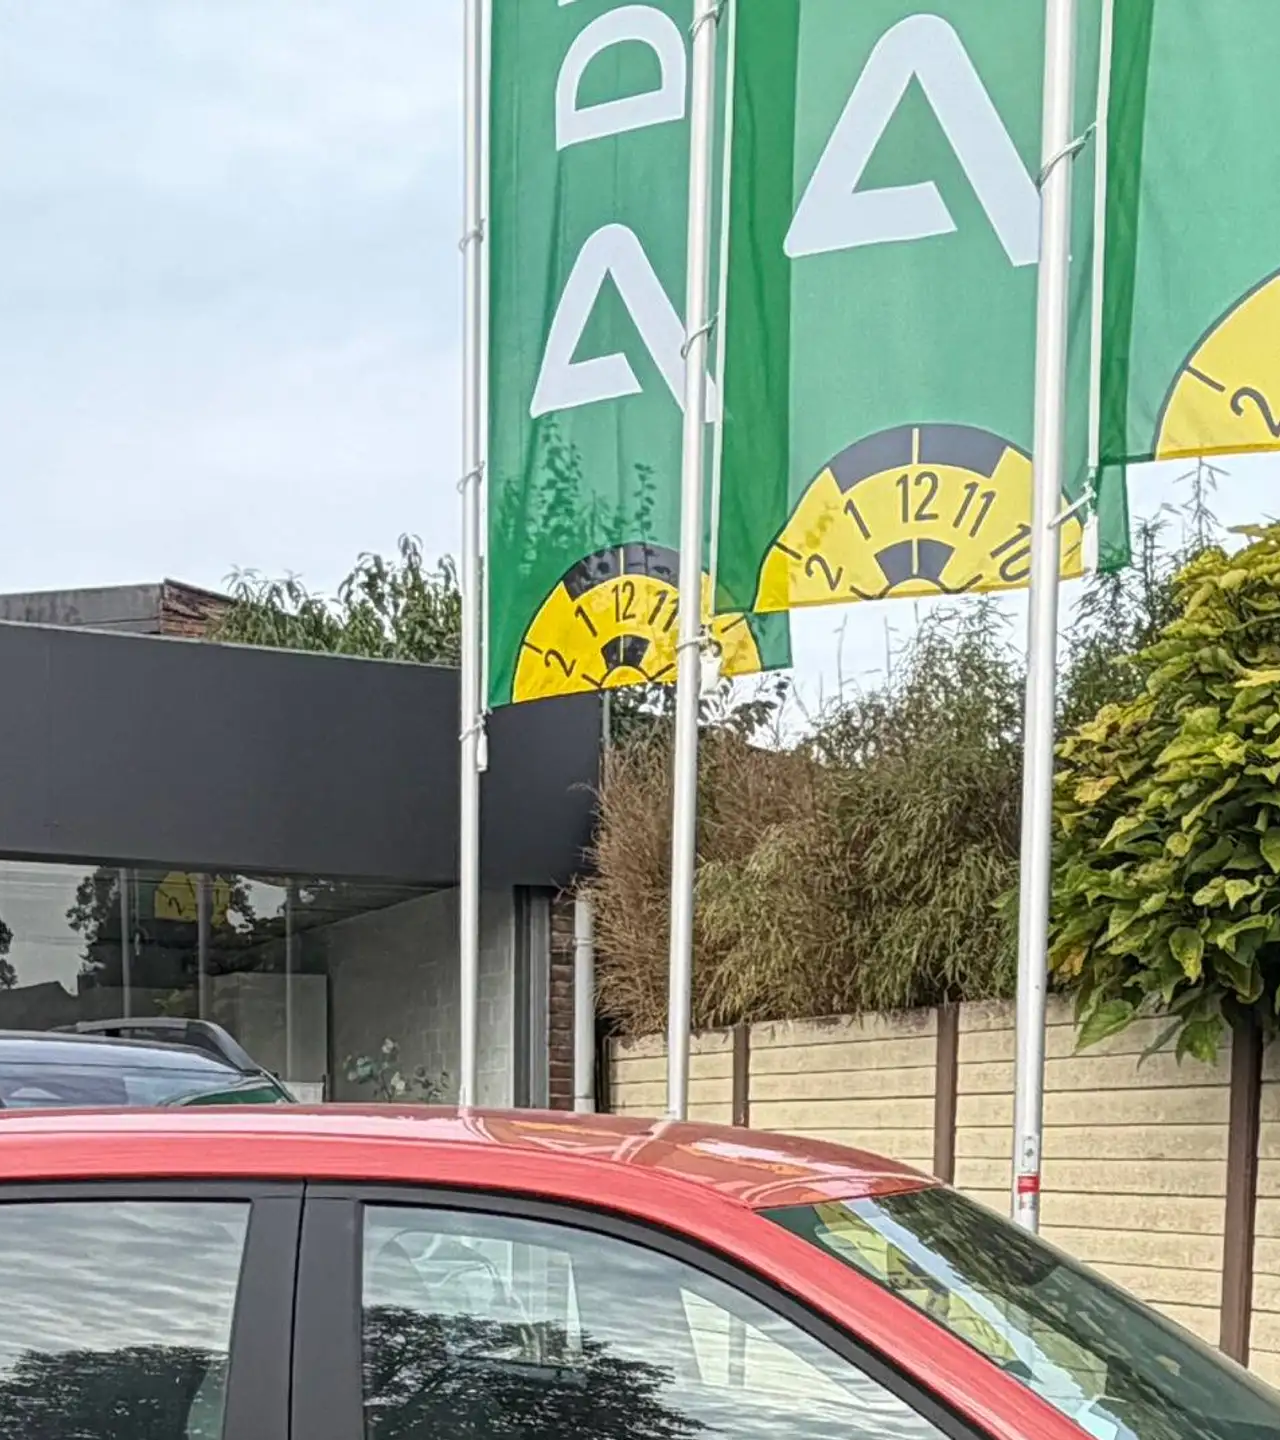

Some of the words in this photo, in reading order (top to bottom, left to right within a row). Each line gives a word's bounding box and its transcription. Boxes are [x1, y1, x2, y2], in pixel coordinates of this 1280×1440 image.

[896, 471, 939, 523] 12
[952, 481, 996, 537] 11
[611, 580, 636, 623] 12
